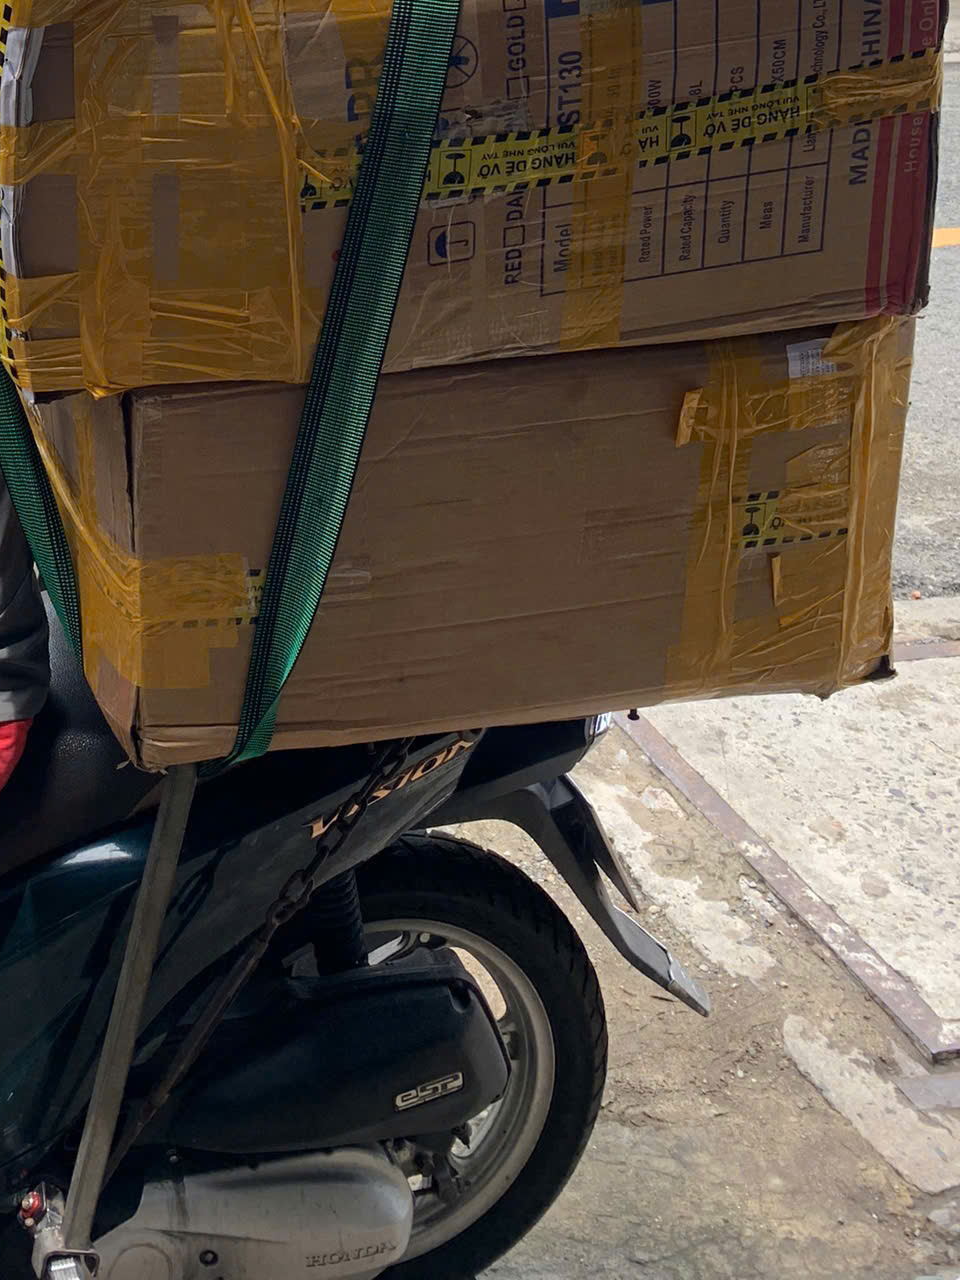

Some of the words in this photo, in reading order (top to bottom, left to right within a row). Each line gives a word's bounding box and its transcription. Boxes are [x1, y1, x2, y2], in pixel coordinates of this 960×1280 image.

[507, 14, 526, 71] GOLD
[681, 194, 696, 231] Capacity
[718, 200, 735, 244] Quantity
[760, 201, 773, 230] Meas
[797, 176, 815, 244] Manufacturer
[552, 223, 573, 272] Model
[679, 232, 692, 261] Rated
[505, 248, 523, 284] RED
[306, 1242, 396, 1268] HONDA
